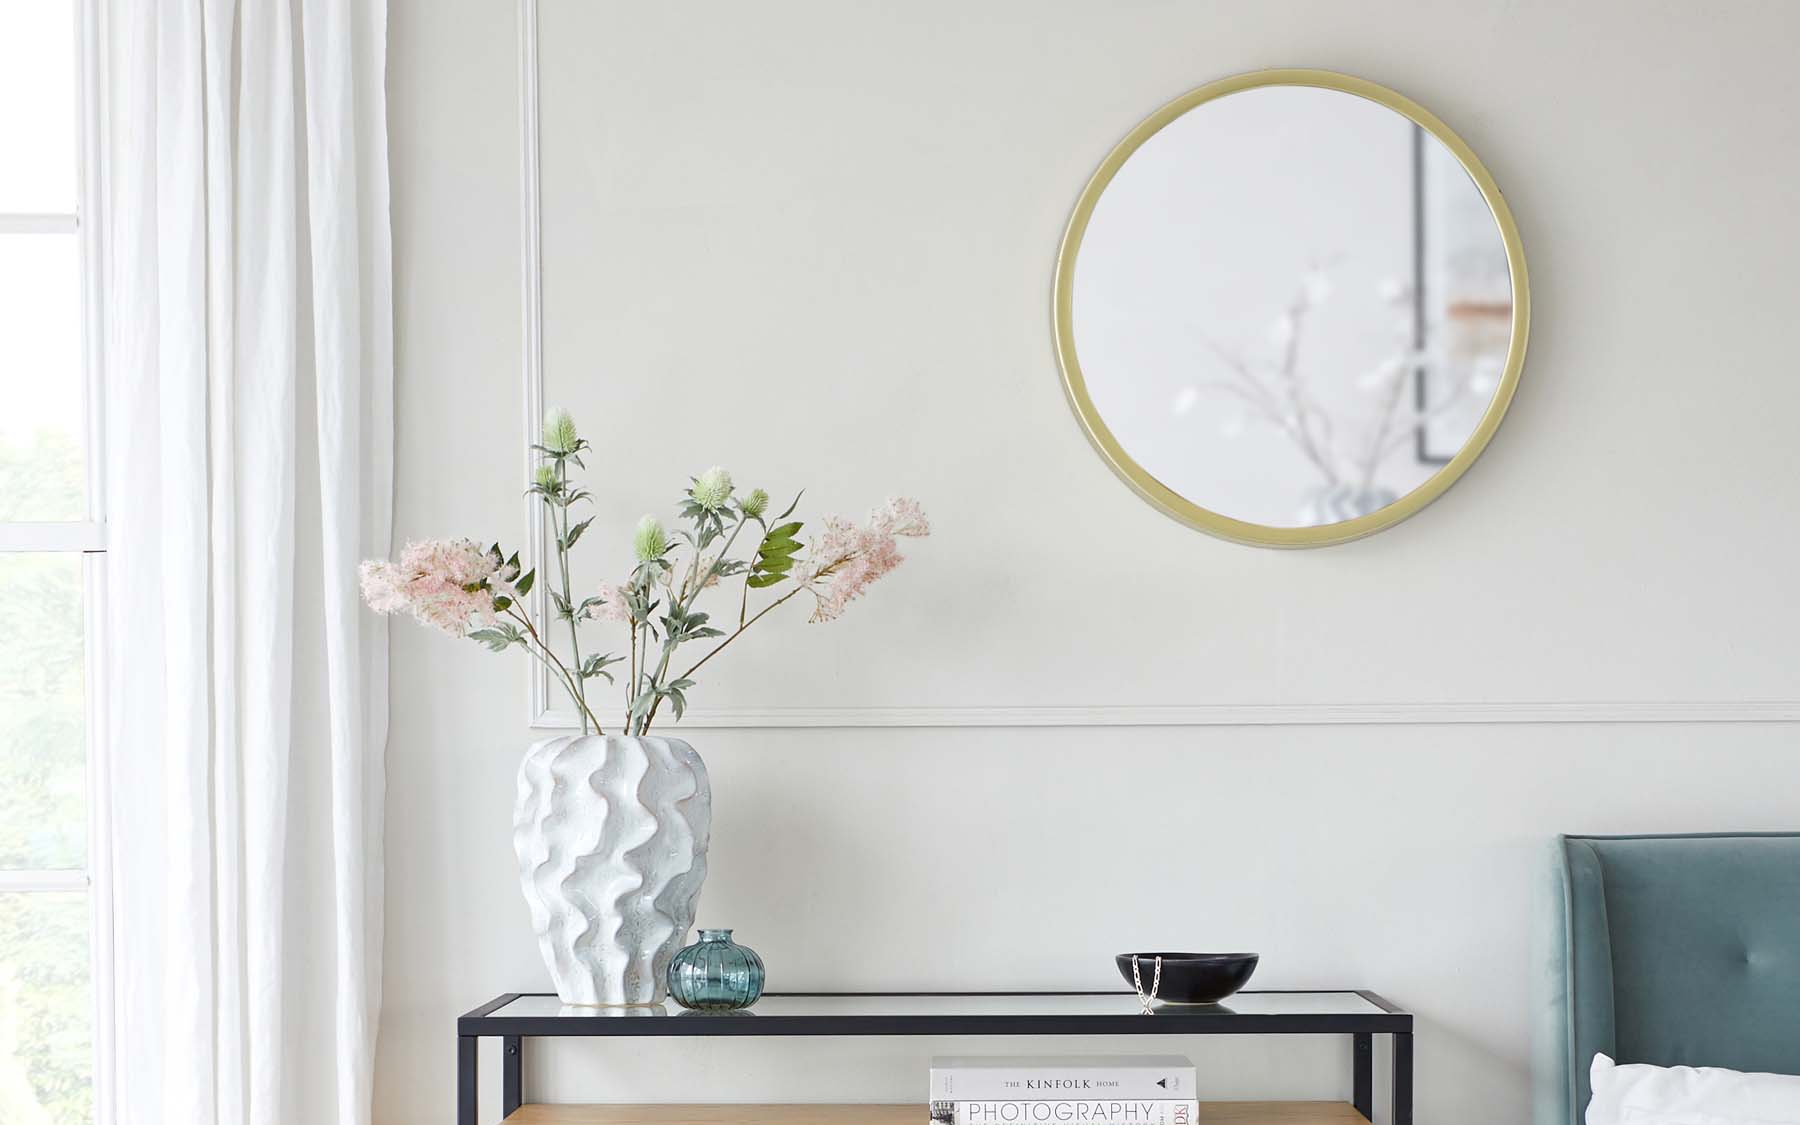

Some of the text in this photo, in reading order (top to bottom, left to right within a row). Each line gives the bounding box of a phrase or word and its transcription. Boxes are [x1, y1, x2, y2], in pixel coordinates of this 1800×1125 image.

[1027, 1079, 1091, 1089] KINFOLK
[969, 1102, 1154, 1121] PHOTOGRAPHY
[1175, 1106, 1186, 1125] DK
